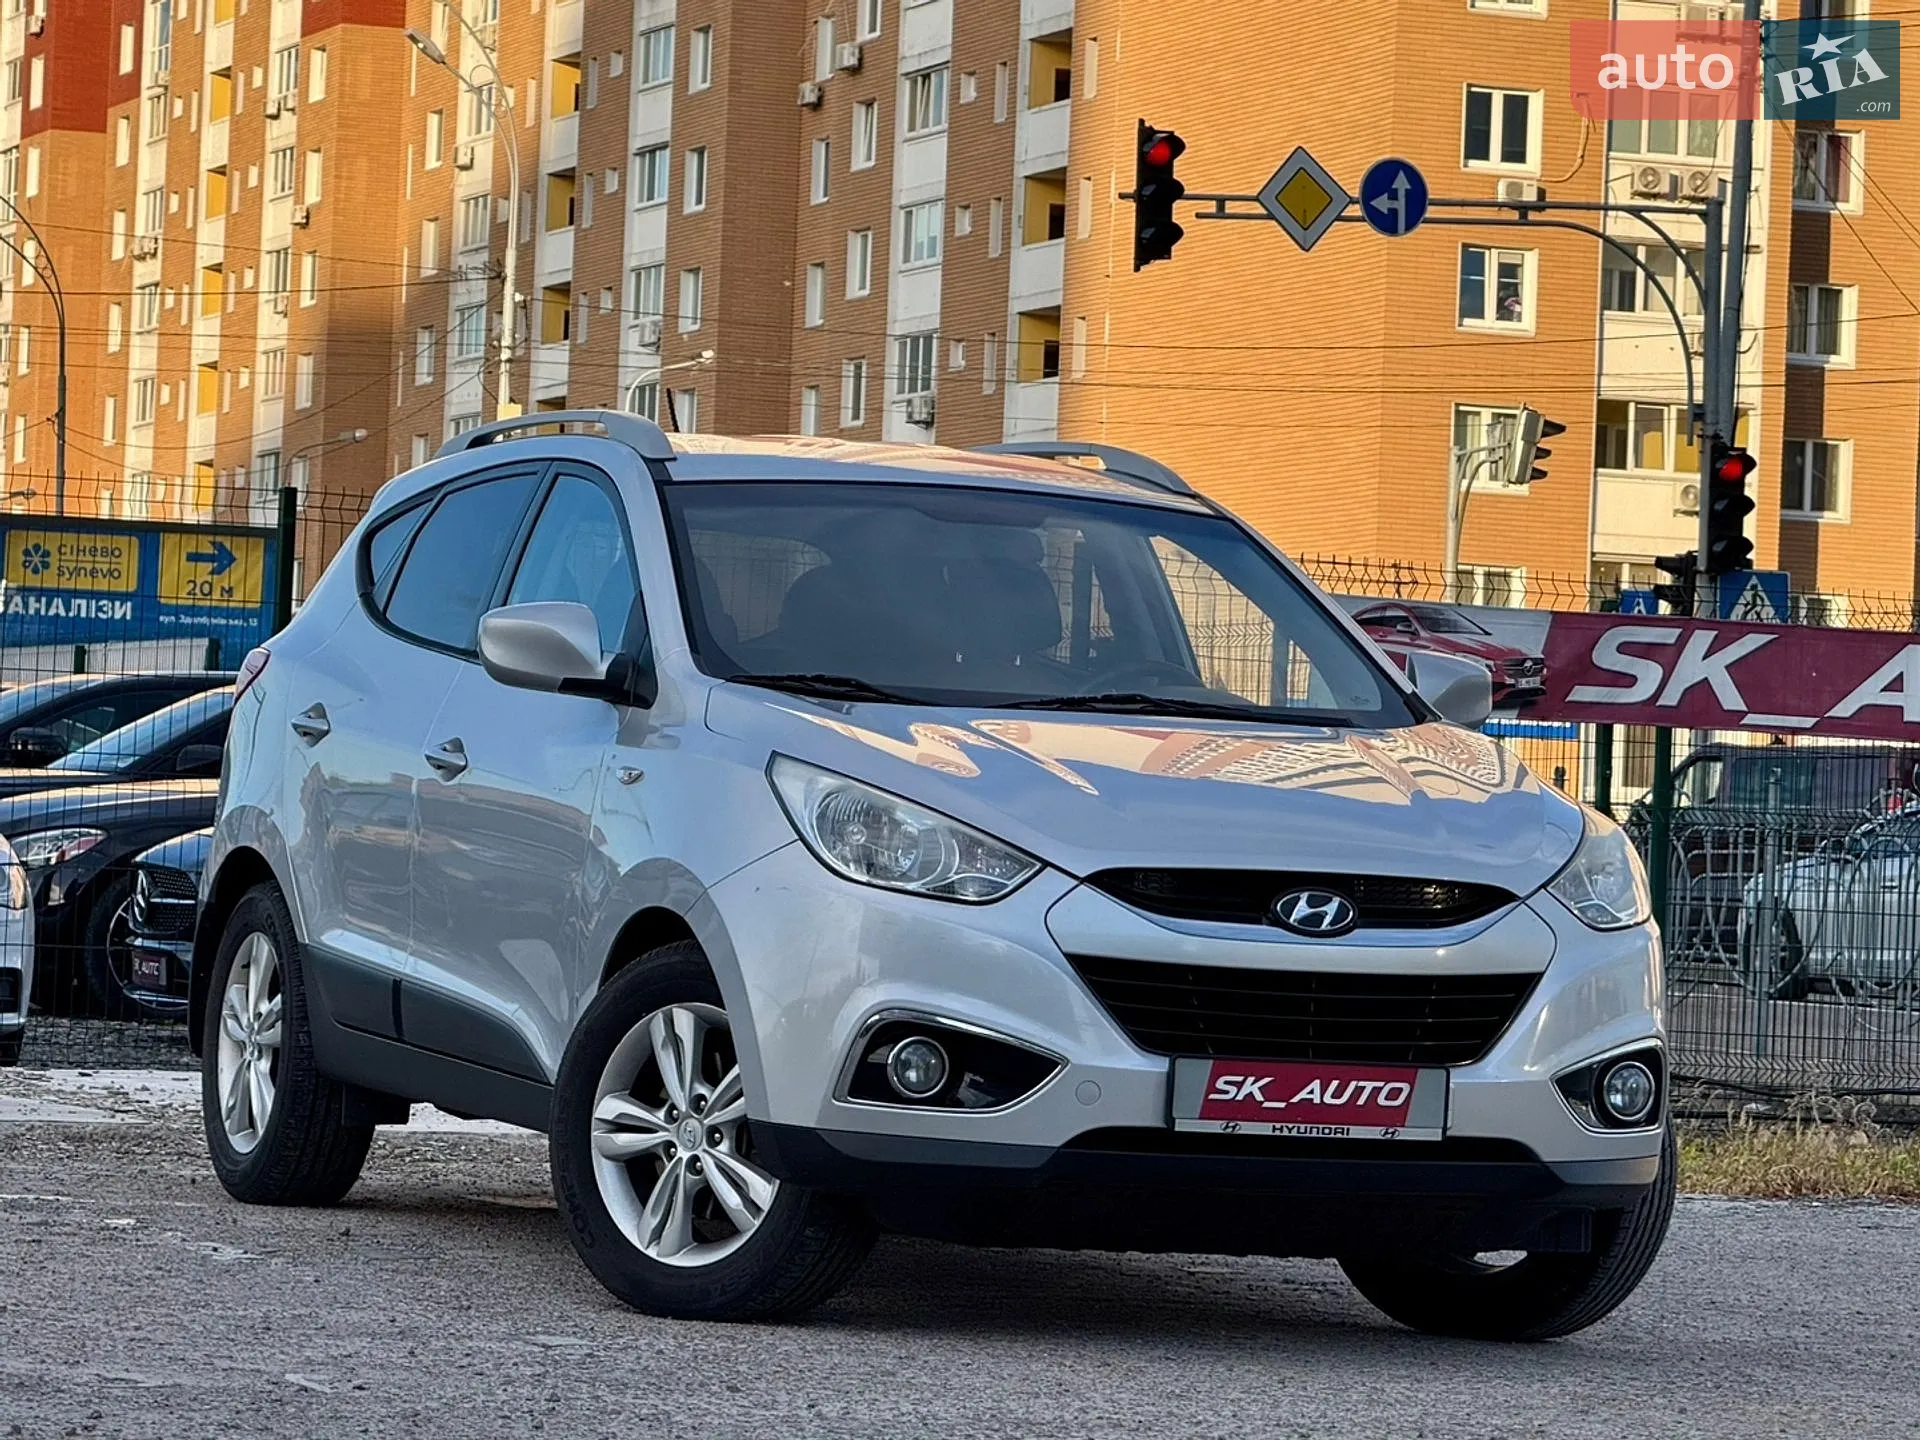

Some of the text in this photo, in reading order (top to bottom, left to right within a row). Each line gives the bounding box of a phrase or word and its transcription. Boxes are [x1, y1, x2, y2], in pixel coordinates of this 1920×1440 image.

[57, 542, 123, 557] сінево
[56, 563, 122, 581] synevo
[186, 579, 213, 597] 20
[7, 596, 132, 620] АНАЛІЗИ
[1208, 1075, 1411, 1108] SK_AUTO
[1272, 1124, 1350, 1136] HYUNDAI
